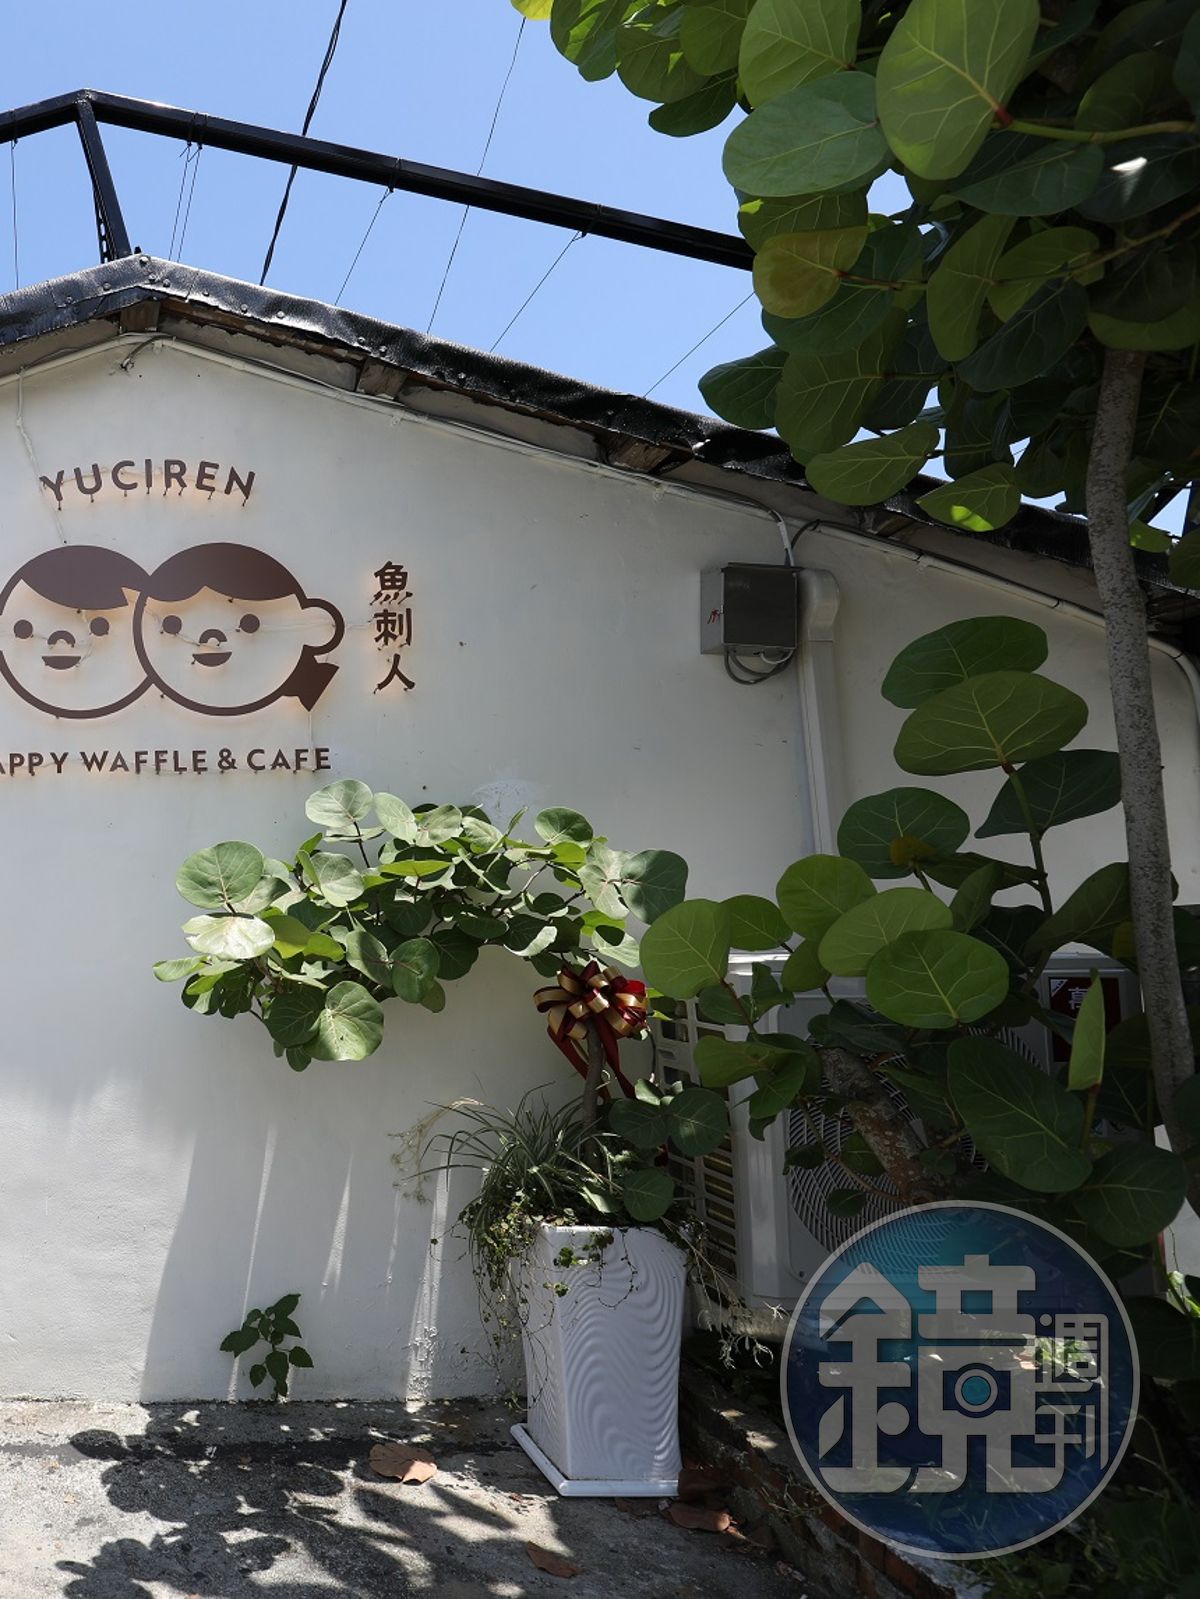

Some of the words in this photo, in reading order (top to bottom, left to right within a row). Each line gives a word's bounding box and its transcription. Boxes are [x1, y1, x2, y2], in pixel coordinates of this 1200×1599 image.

[39, 457, 255, 501] YUCIREN
[374, 561, 415, 693] 魚刺人
